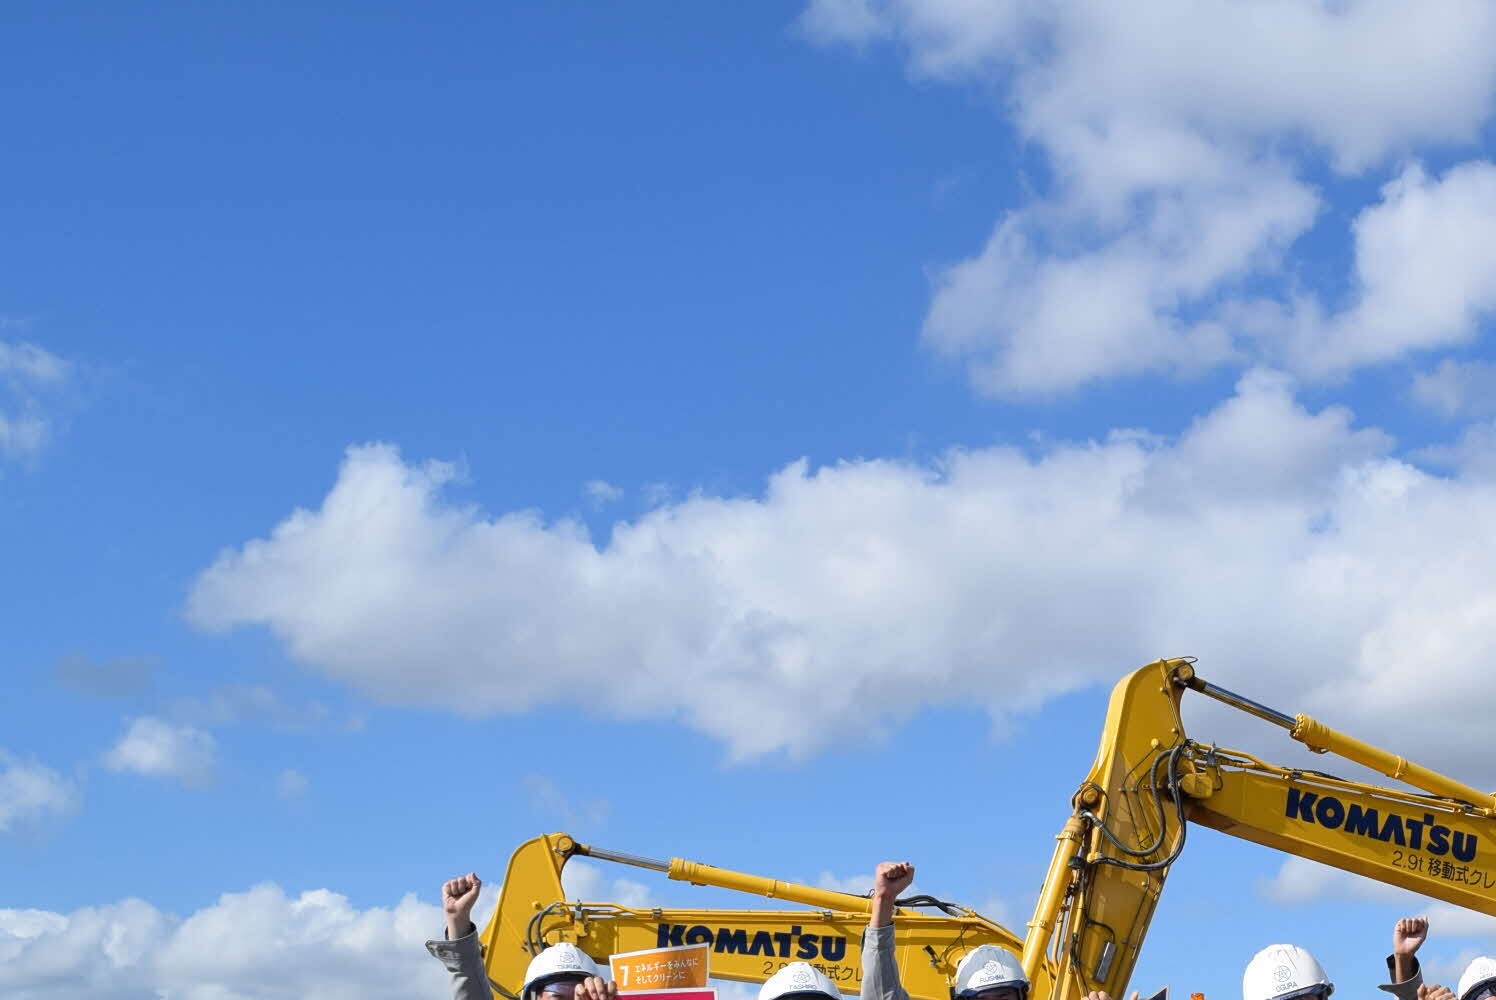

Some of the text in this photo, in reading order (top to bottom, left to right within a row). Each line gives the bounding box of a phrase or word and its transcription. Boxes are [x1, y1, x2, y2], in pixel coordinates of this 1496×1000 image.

[1286, 787, 1478, 863] KOMATSU
[1392, 850, 1423, 873] 2.9t
[657, 923, 847, 962] KOMATSU
[618, 965, 630, 987] 7
[634, 957, 699, 973] エネルギーをみんなに
[635, 971, 687, 985] そしてクリーンに
[1275, 981, 1298, 993] OGURA
